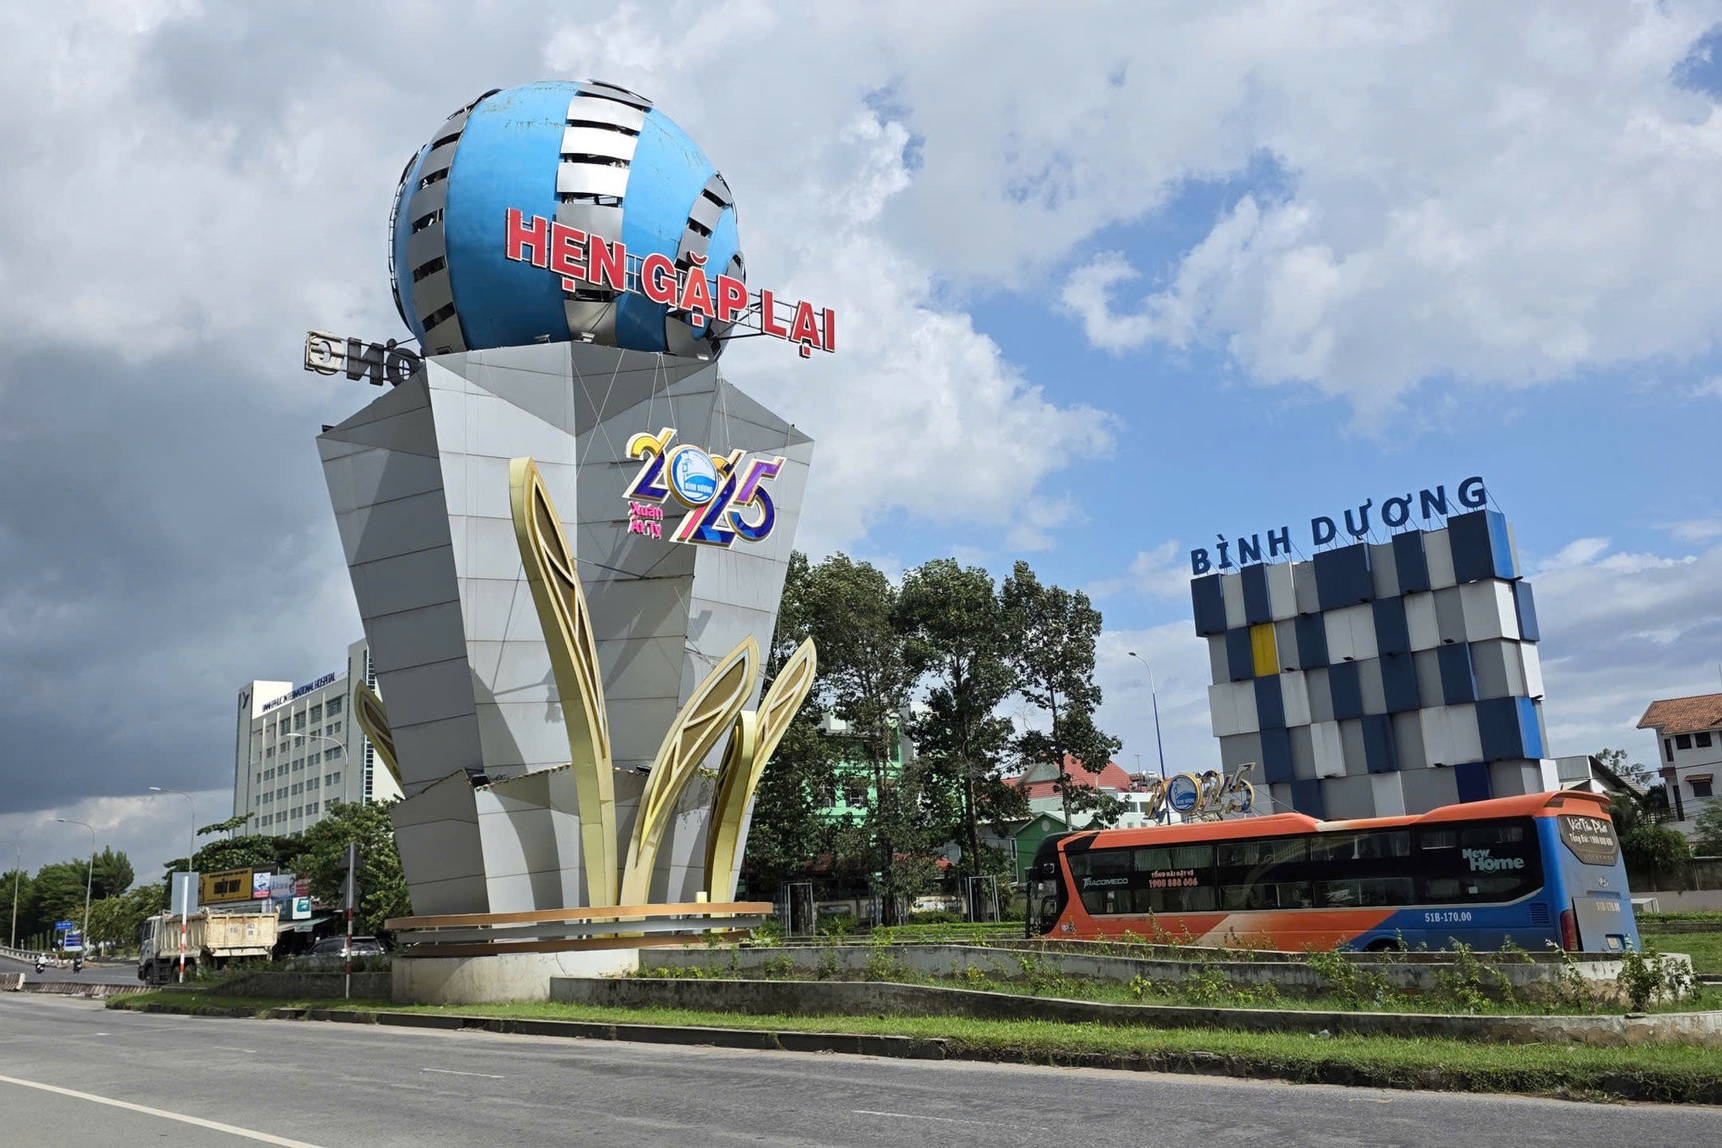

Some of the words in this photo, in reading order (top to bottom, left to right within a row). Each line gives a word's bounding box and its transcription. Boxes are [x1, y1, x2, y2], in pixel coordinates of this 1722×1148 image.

[505, 207, 626, 293] HẸN
[641, 251, 749, 327] GẶP
[760, 288, 836, 358] LẠI
[1190, 526, 1291, 575] BÌNH
[1311, 476, 1488, 546] DƯƠNG
[1462, 848, 1491, 859] New
[1470, 857, 1525, 872] Home
[1082, 877, 1129, 888] TRACOMECO
[1425, 912, 1472, 922] 51B-170.00
